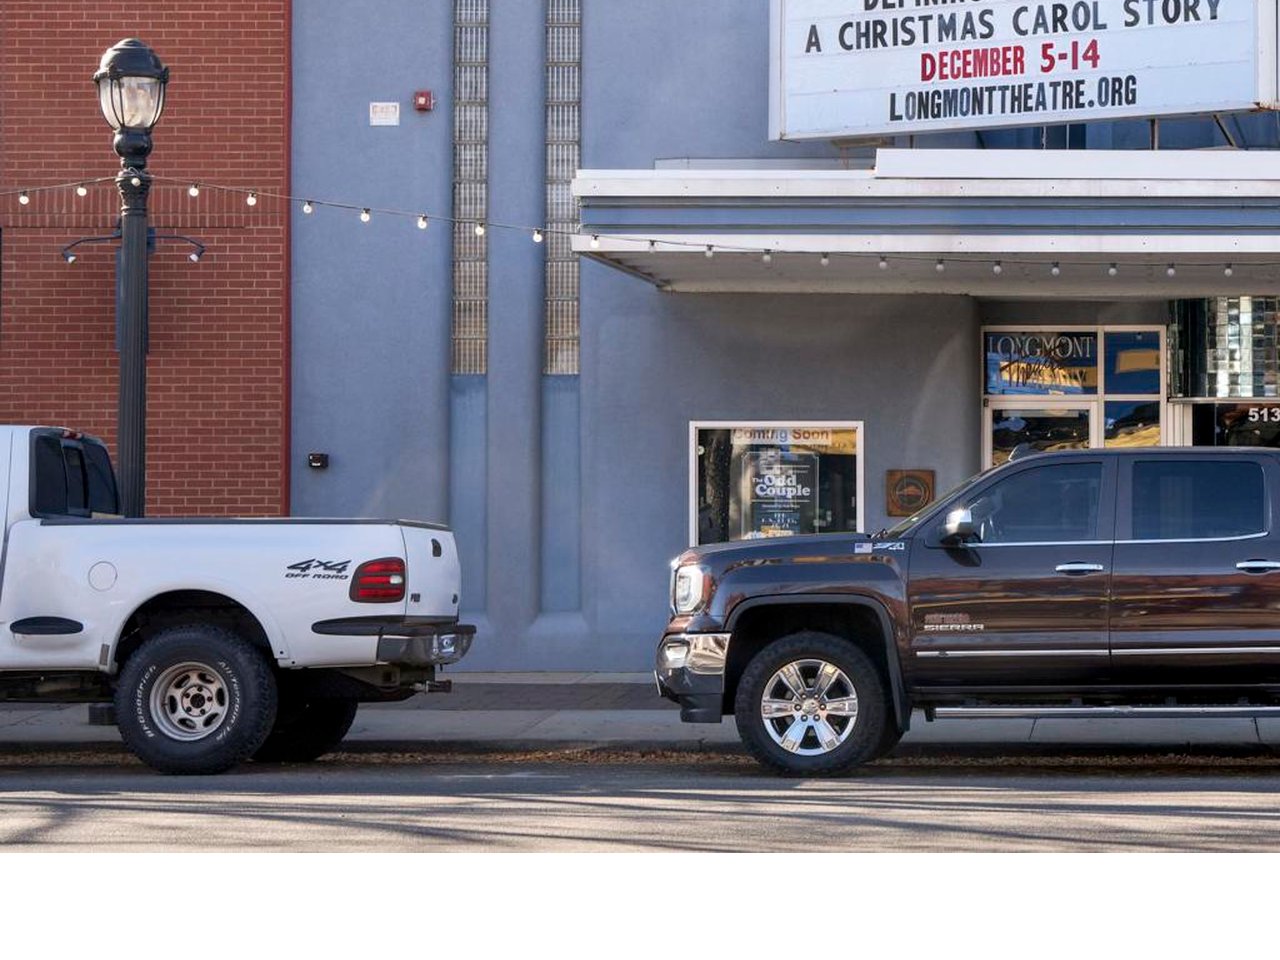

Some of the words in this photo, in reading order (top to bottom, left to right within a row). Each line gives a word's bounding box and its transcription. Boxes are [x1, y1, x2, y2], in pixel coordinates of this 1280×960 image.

[805, 25, 821, 53] A
[838, 8, 995, 50] CHRISTMAS
[1013, 0, 1107, 36] CAROL
[921, 45, 1025, 82] DECEMBER
[1041, 39, 1100, 73] 5-14
[890, 75, 1137, 121] LONGMONTTHEATRE.ORG
[1248, 407, 1280, 422] 513
[792, 428, 829, 440] Soon
[764, 474, 797, 487] Odd
[755, 485, 811, 498] Couple
